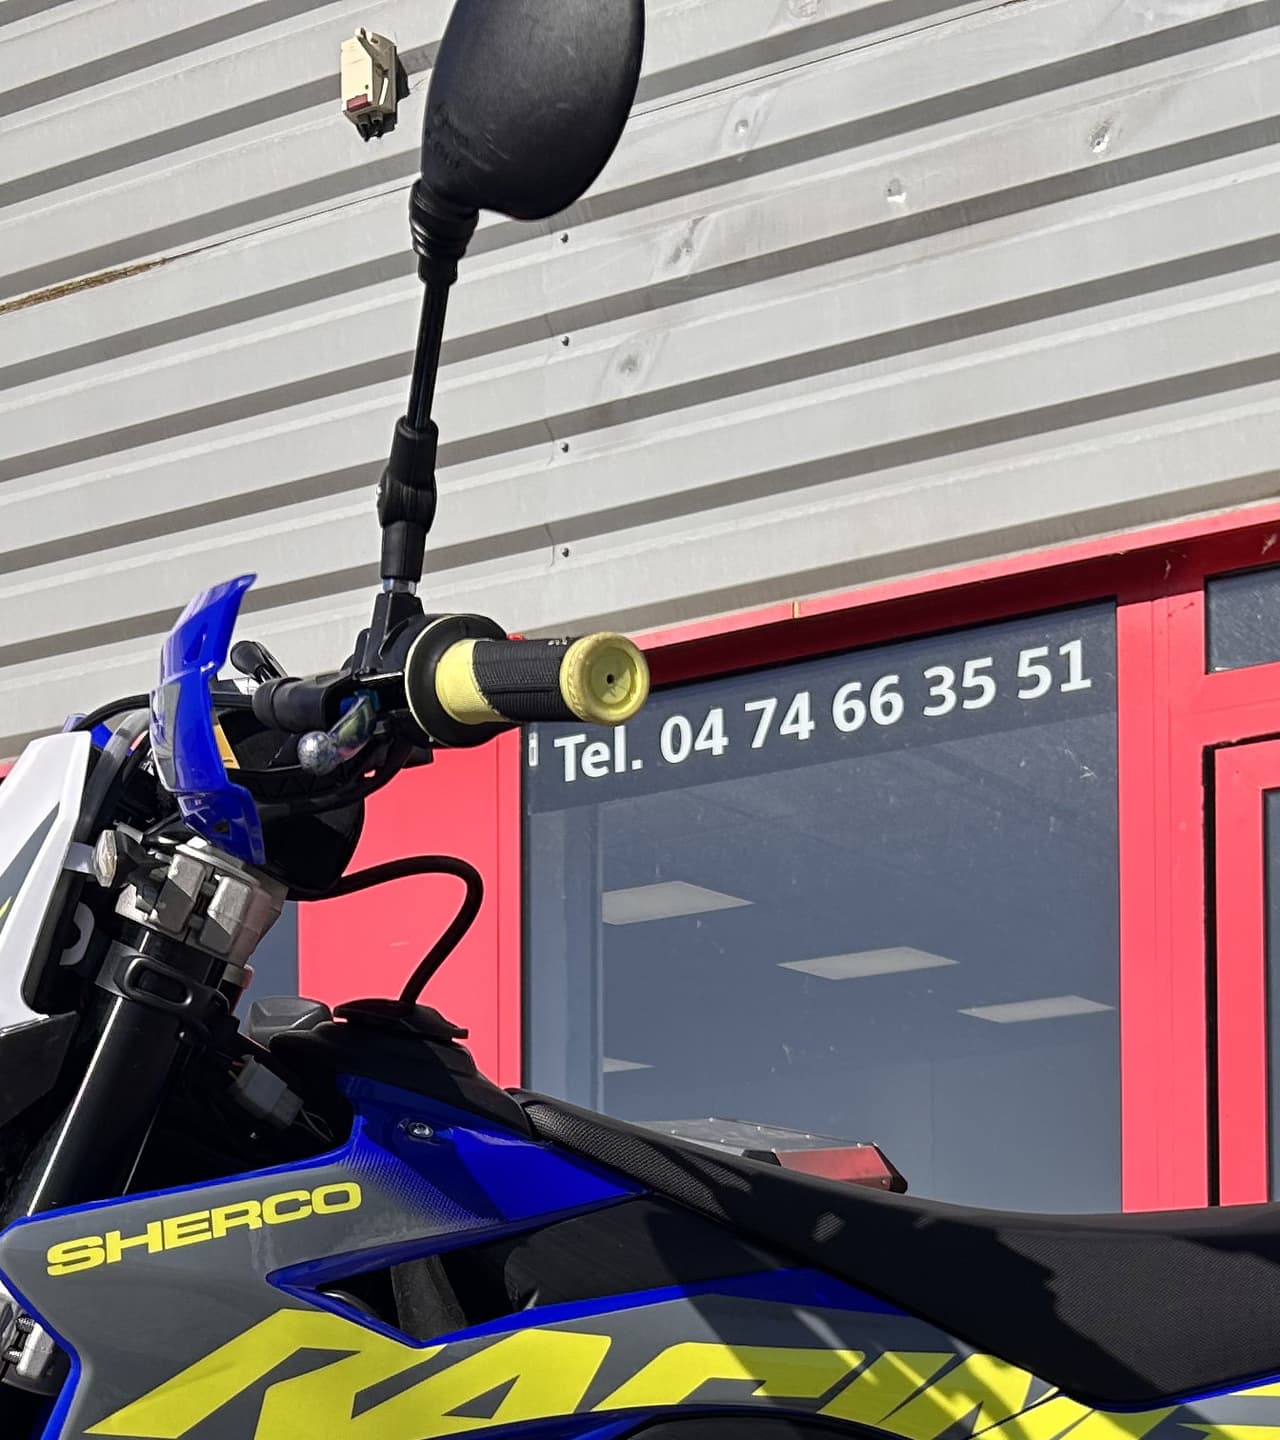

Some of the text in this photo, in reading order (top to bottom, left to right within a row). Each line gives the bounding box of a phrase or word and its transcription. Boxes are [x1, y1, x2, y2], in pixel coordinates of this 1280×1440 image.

[553, 639, 1092, 782] Tel. 04 74 66 35 51
[46, 1181, 362, 1276] SHERCO
